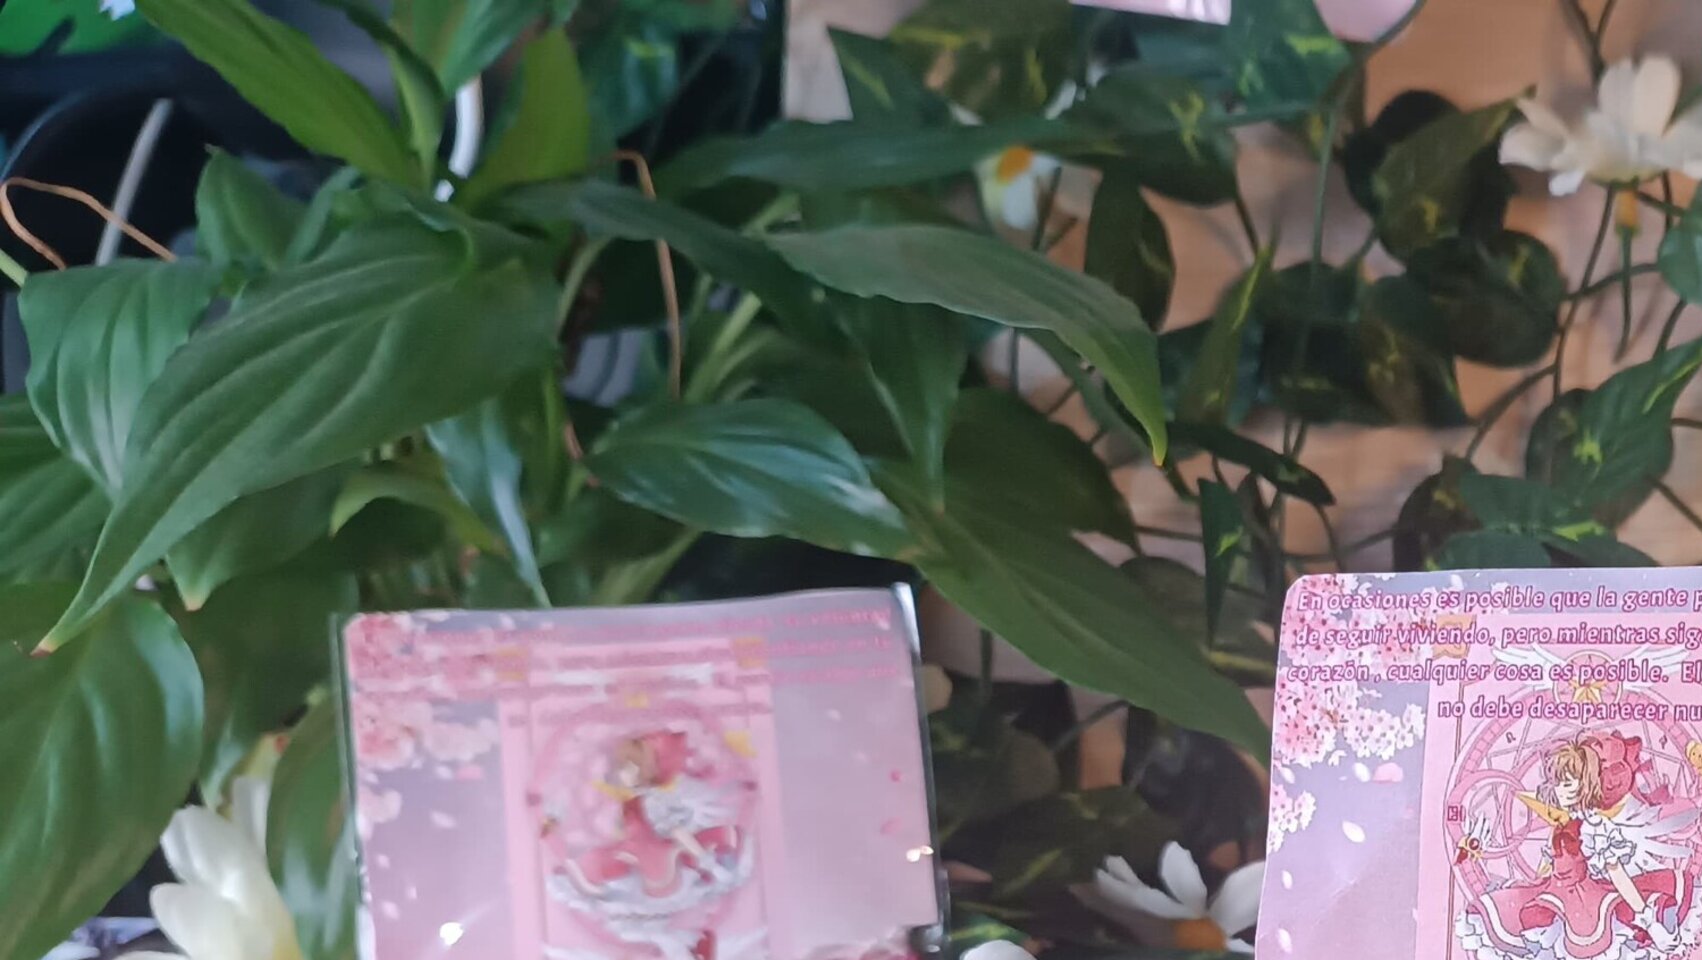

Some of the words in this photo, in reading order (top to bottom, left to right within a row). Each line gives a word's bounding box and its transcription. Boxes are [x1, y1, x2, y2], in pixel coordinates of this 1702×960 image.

[1297, 591, 1327, 611] En
[1327, 590, 1432, 610] ocasiones
[1436, 591, 1460, 607] es
[1464, 586, 1544, 612] posible
[1550, 590, 1592, 612] que
[1597, 585, 1618, 607] la
[1622, 587, 1689, 612] gente
[1296, 625, 1321, 646] de
[1323, 627, 1391, 649] seguir
[1397, 622, 1496, 647] viviendo,
[1501, 626, 1552, 649] pero
[1557, 622, 1660, 646] mientras
[1386, 659, 1490, 684] cualquier
[1494, 662, 1544, 682] cosa
[1548, 663, 1574, 682] es
[1578, 659, 1669, 685] posible.
[1680, 661, 1702, 683] El
[1437, 700, 1465, 718] no
[1470, 696, 1523, 718] debe
[1528, 698, 1669, 724] desaparecer
